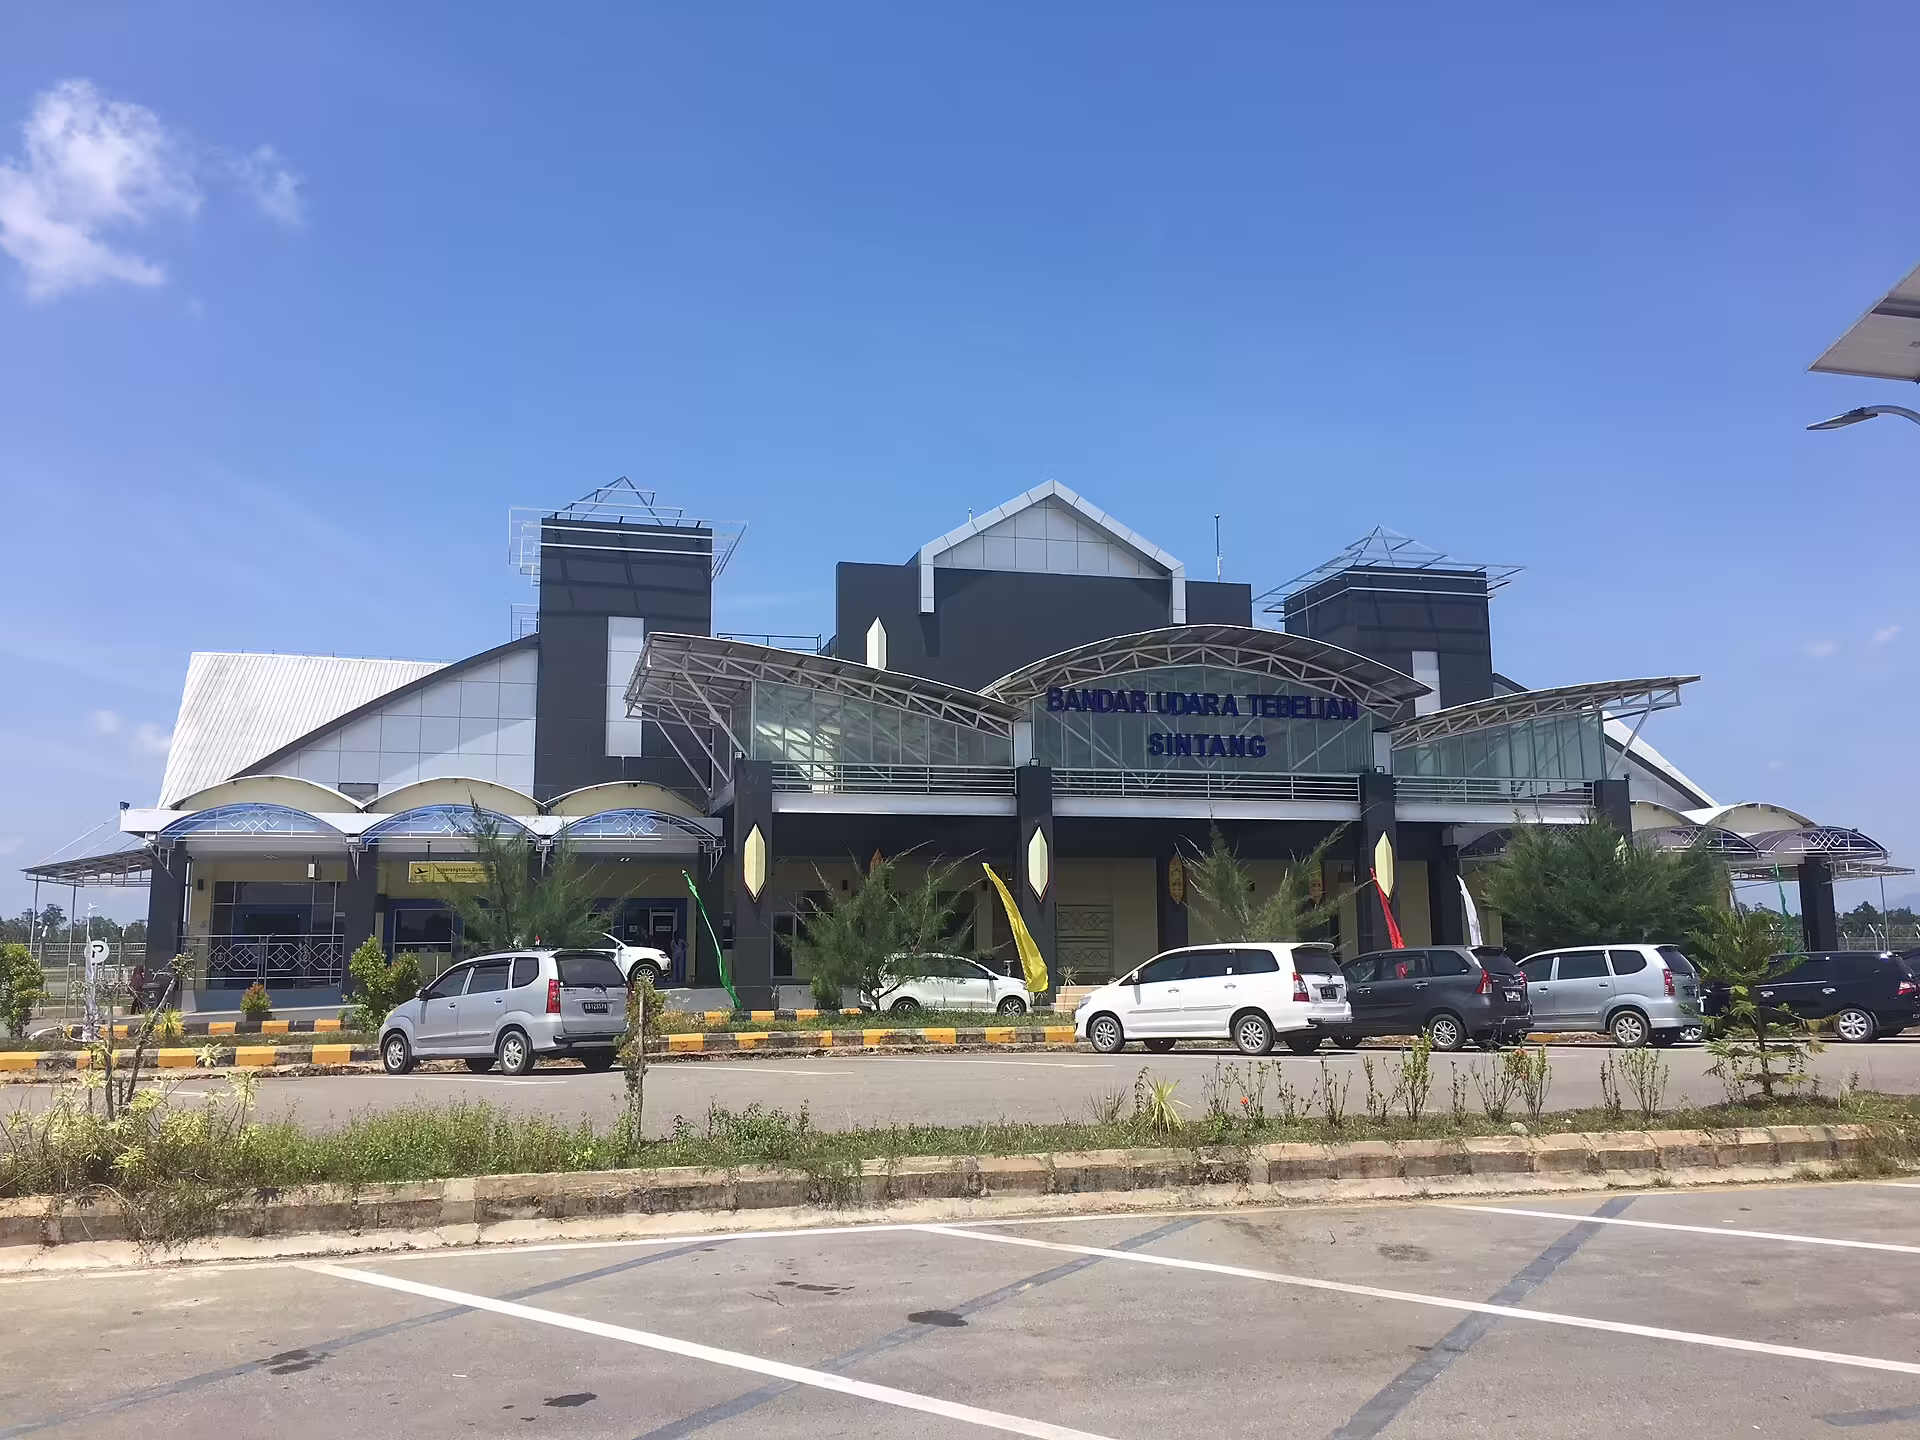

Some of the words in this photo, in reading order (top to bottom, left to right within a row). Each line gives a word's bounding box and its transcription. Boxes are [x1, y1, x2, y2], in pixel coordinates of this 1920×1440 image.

[1047, 687, 1147, 713] BANDAR
[1157, 691, 1239, 717] UDARA
[1247, 693, 1358, 720] TEBELIAN
[1149, 733, 1266, 758] SINTANG
[92, 944, 105, 959] P
